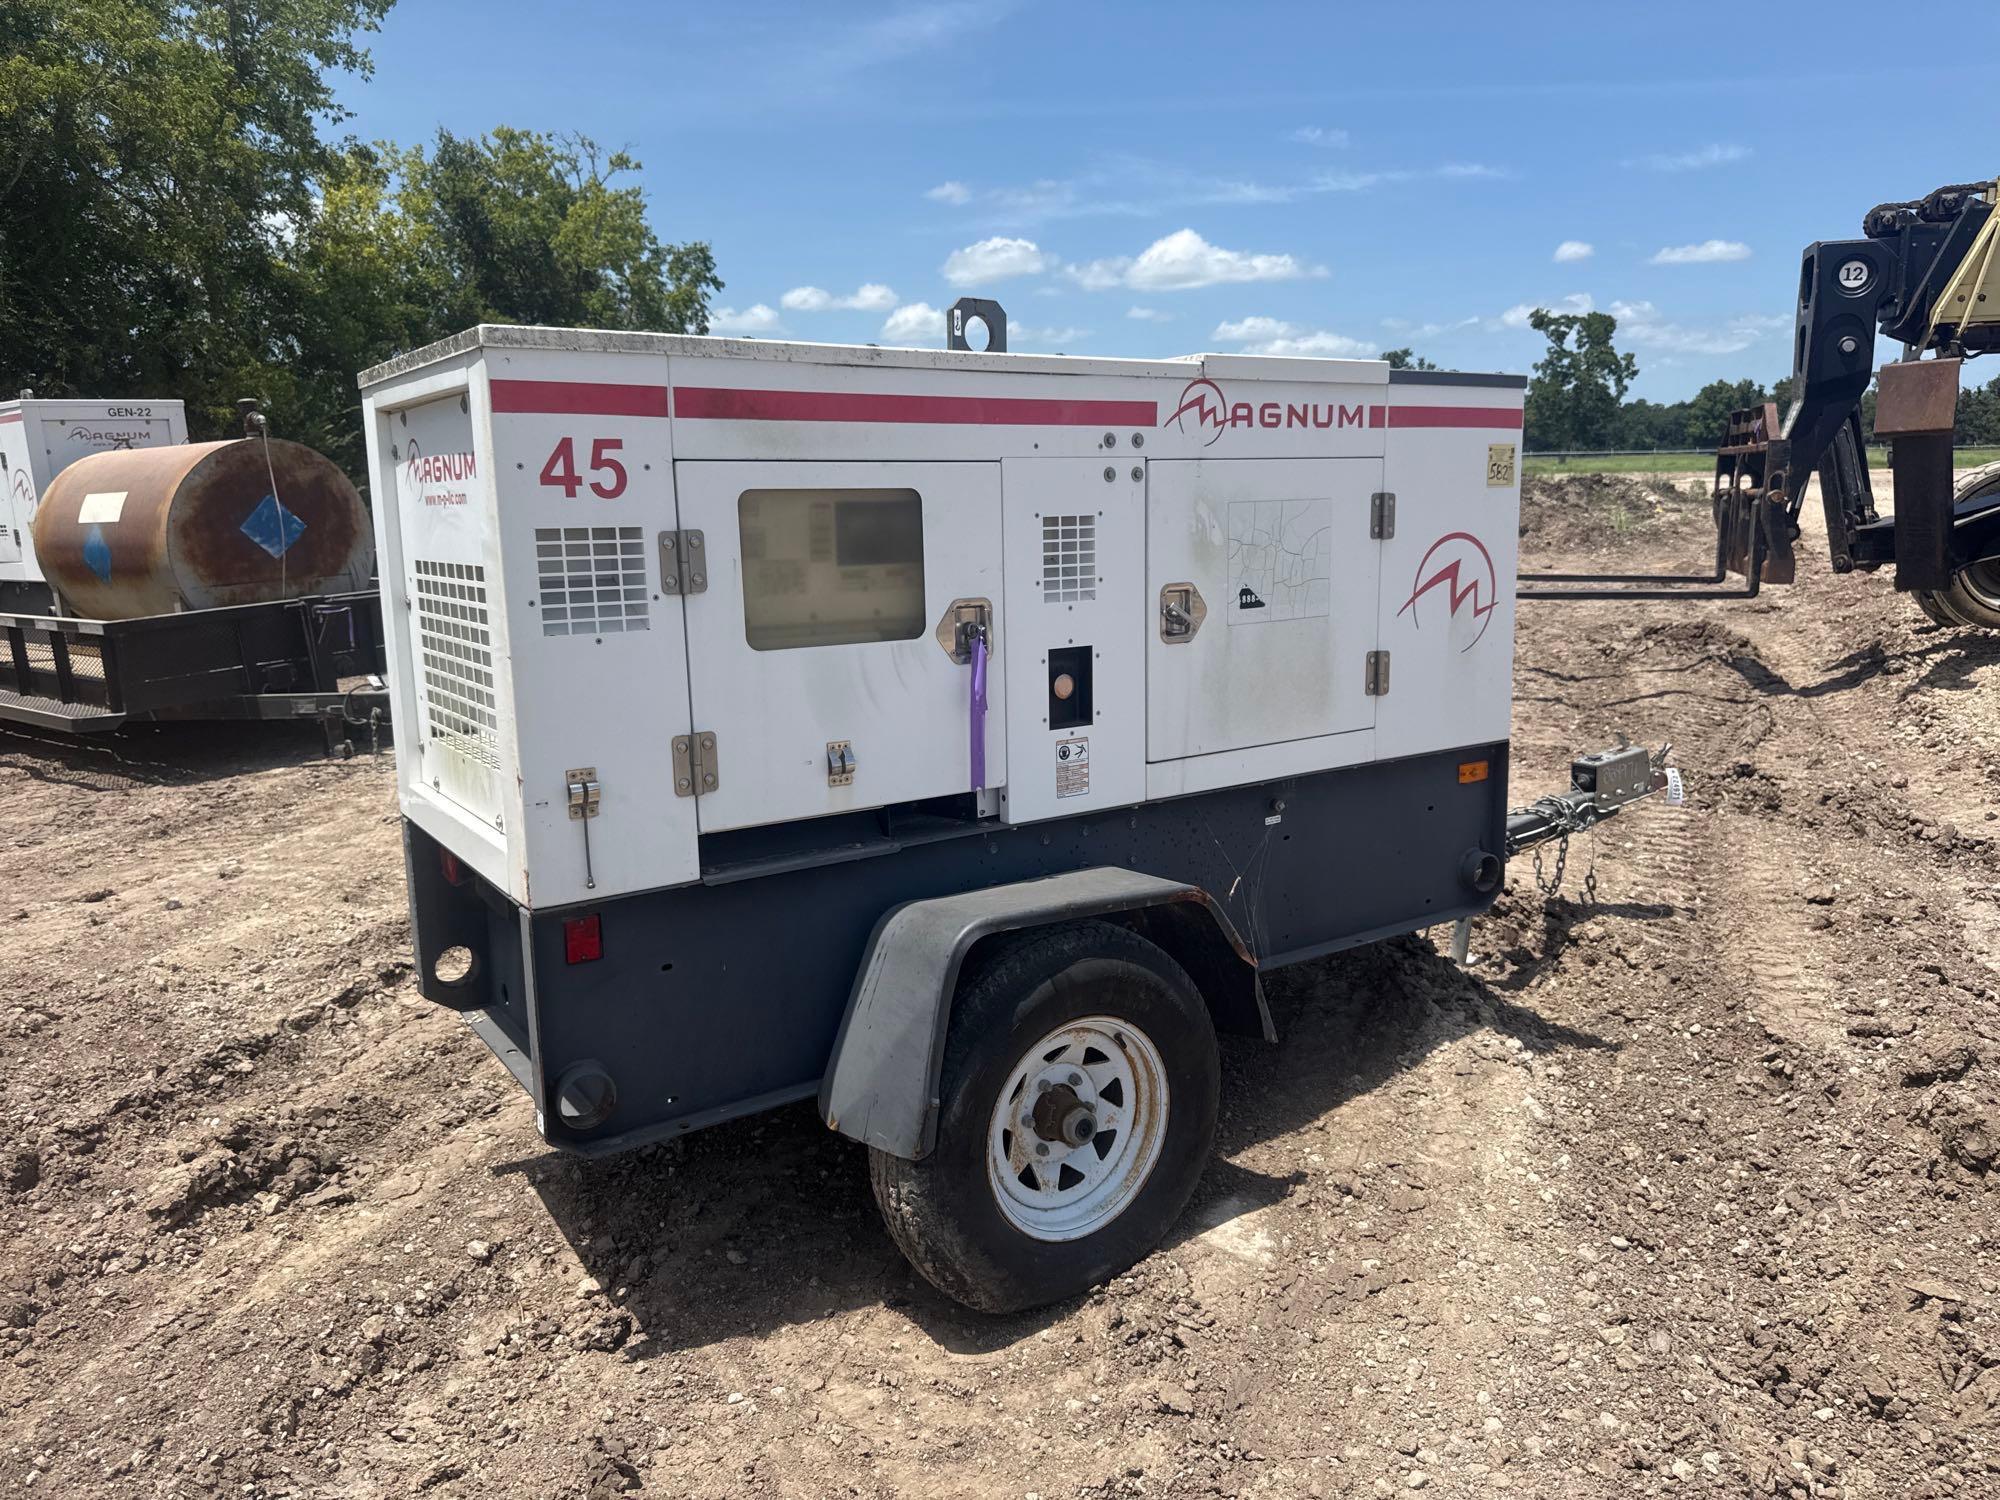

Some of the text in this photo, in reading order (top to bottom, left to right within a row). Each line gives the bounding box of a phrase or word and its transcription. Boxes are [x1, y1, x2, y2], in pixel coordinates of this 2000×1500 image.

[1843, 266, 1864, 281] 12
[108, 407, 152, 417] GEN-22
[1164, 386, 1363, 435] MAGNUM
[539, 436, 628, 499] 45
